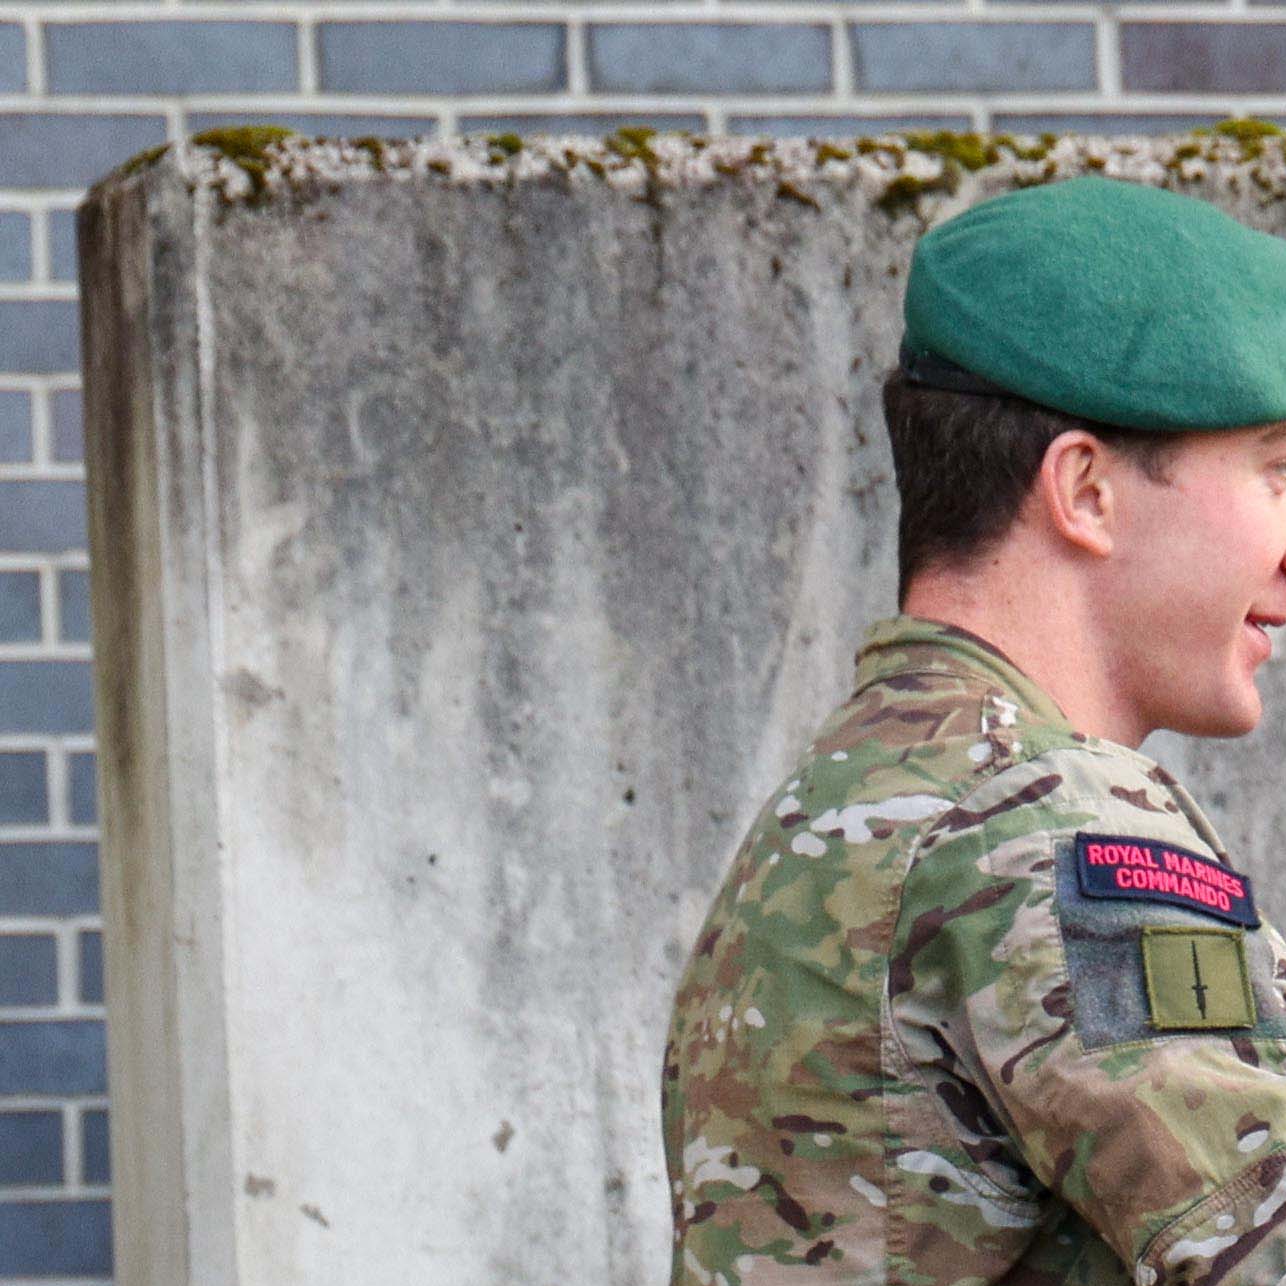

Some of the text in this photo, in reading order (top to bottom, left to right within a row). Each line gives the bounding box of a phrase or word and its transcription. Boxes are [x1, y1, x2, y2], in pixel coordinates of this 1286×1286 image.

[1087, 844, 1245, 898] ROYAL MARINES
[1116, 868, 1232, 911] COMMANDO
